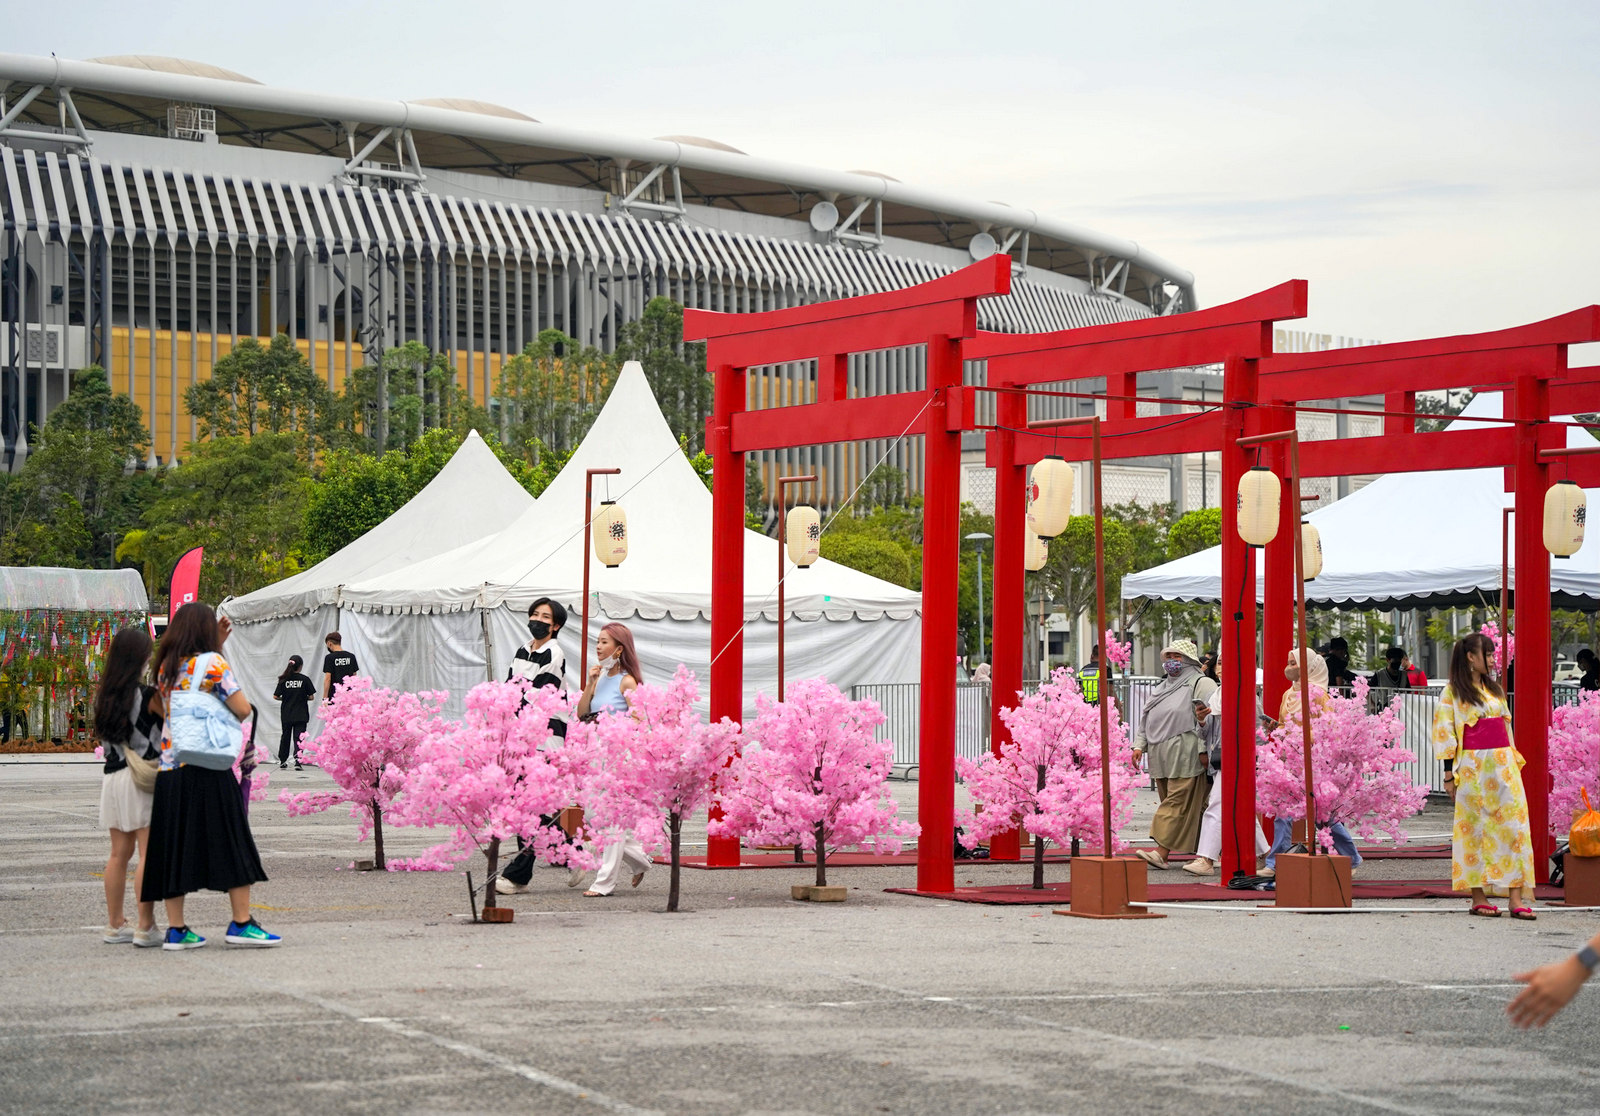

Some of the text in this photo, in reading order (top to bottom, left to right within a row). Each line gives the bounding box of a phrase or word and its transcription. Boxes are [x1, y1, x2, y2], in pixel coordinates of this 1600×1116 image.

[612, 524, 625, 537] 祭
[810, 525, 820, 539] 祭
[334, 658, 351, 666] CREW
[285, 680, 303, 689] CREW
